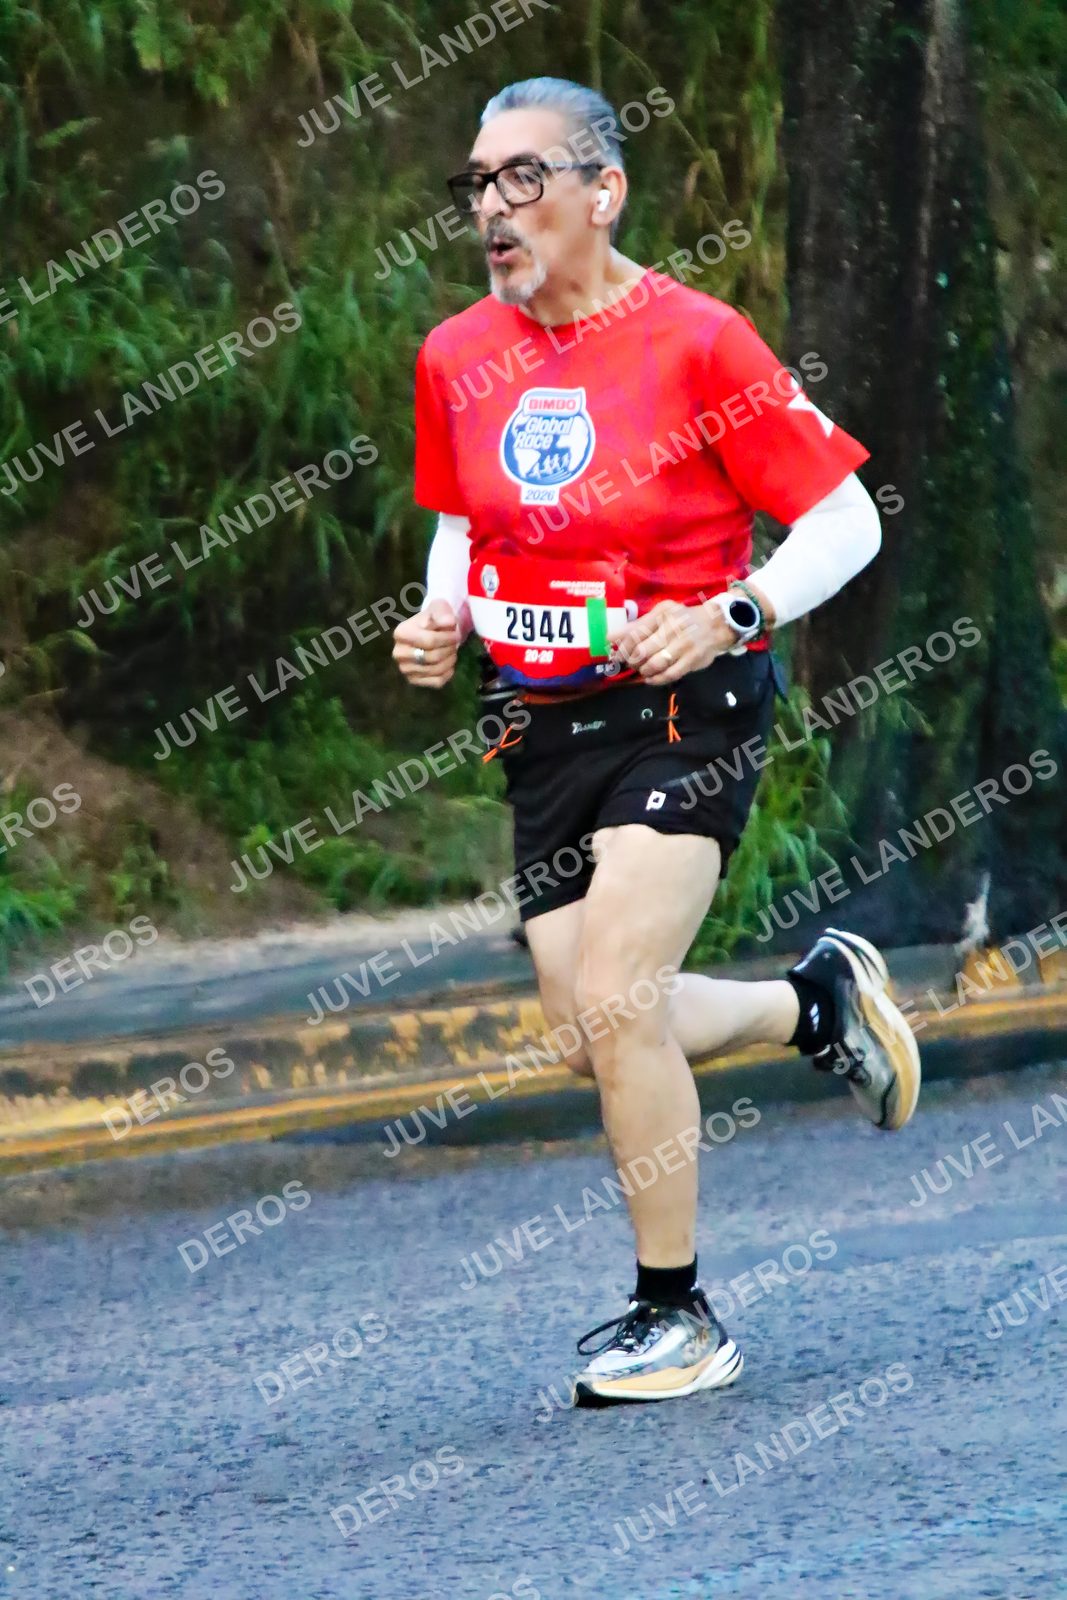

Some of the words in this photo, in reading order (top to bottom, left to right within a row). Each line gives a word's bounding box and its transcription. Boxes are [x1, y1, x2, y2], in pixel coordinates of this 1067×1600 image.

[525, 416, 575, 434] Global
[514, 432, 553, 449] Race
[524, 489, 554, 501] 2026
[506, 606, 574, 643] 2944
